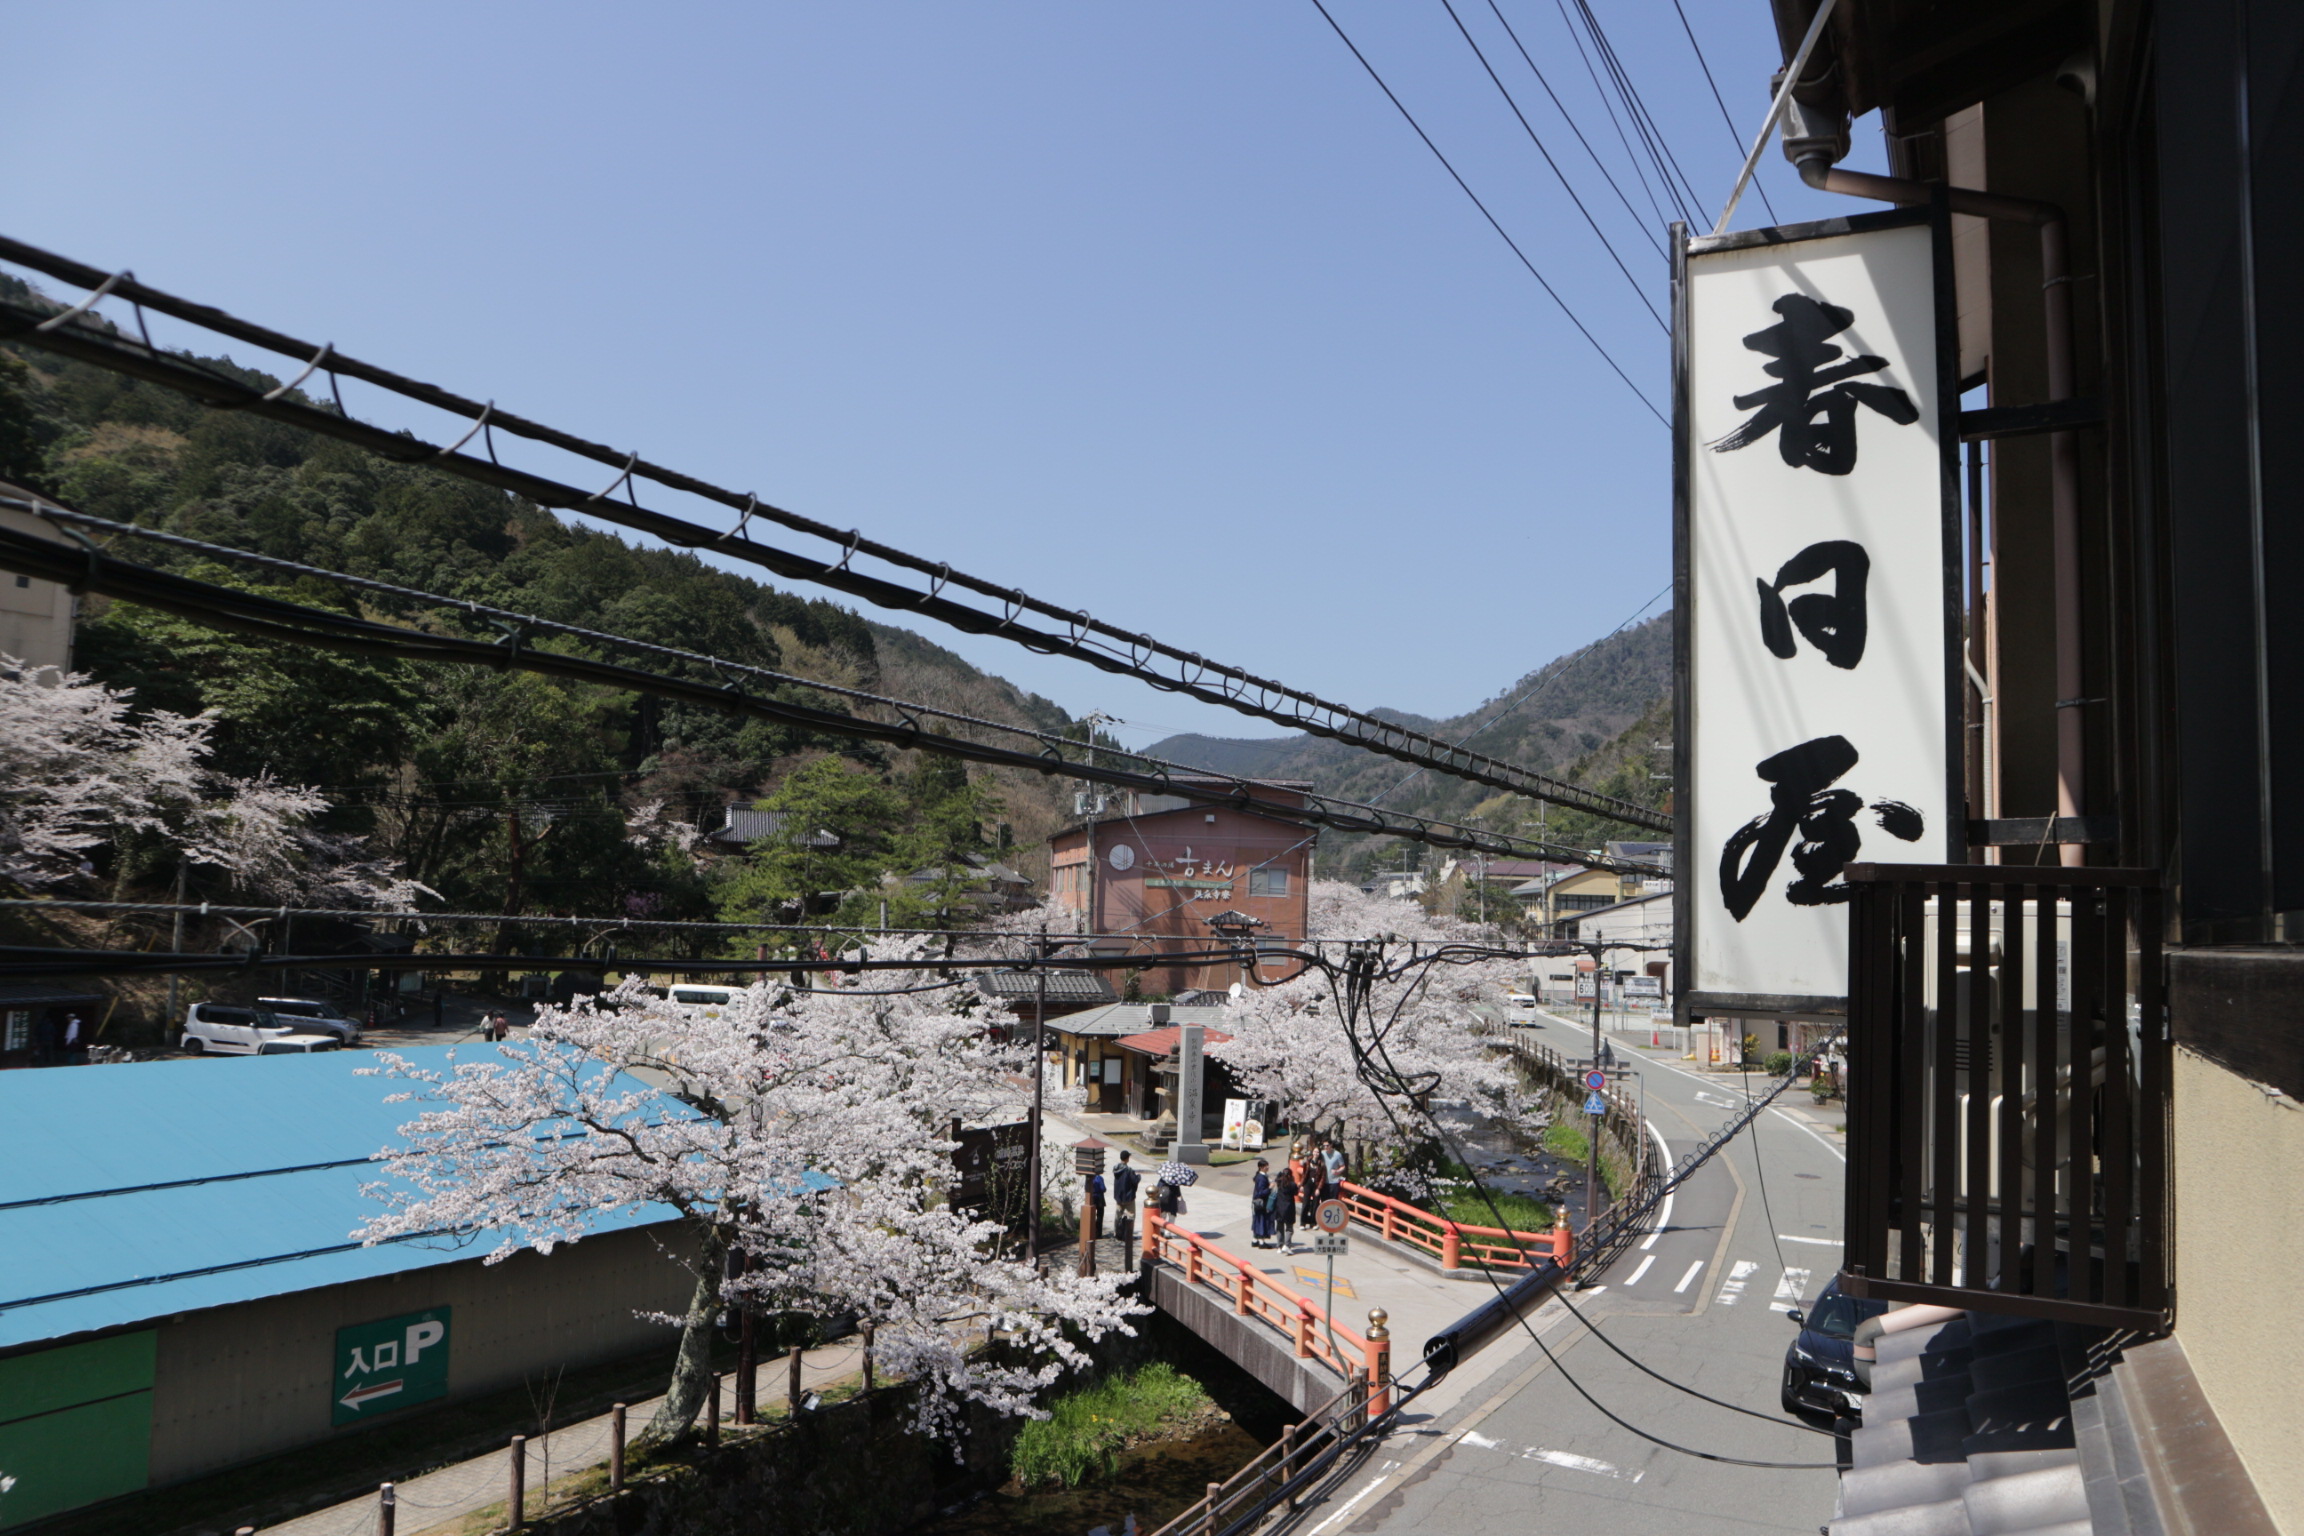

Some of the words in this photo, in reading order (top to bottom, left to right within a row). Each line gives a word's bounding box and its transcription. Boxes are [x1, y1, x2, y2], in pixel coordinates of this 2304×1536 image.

[1704, 292, 1925, 923] 春日屋
[1175, 845, 1234, 878] 古まん
[344, 1340, 398, 1379] 入口
[405, 1320, 444, 1366] P
